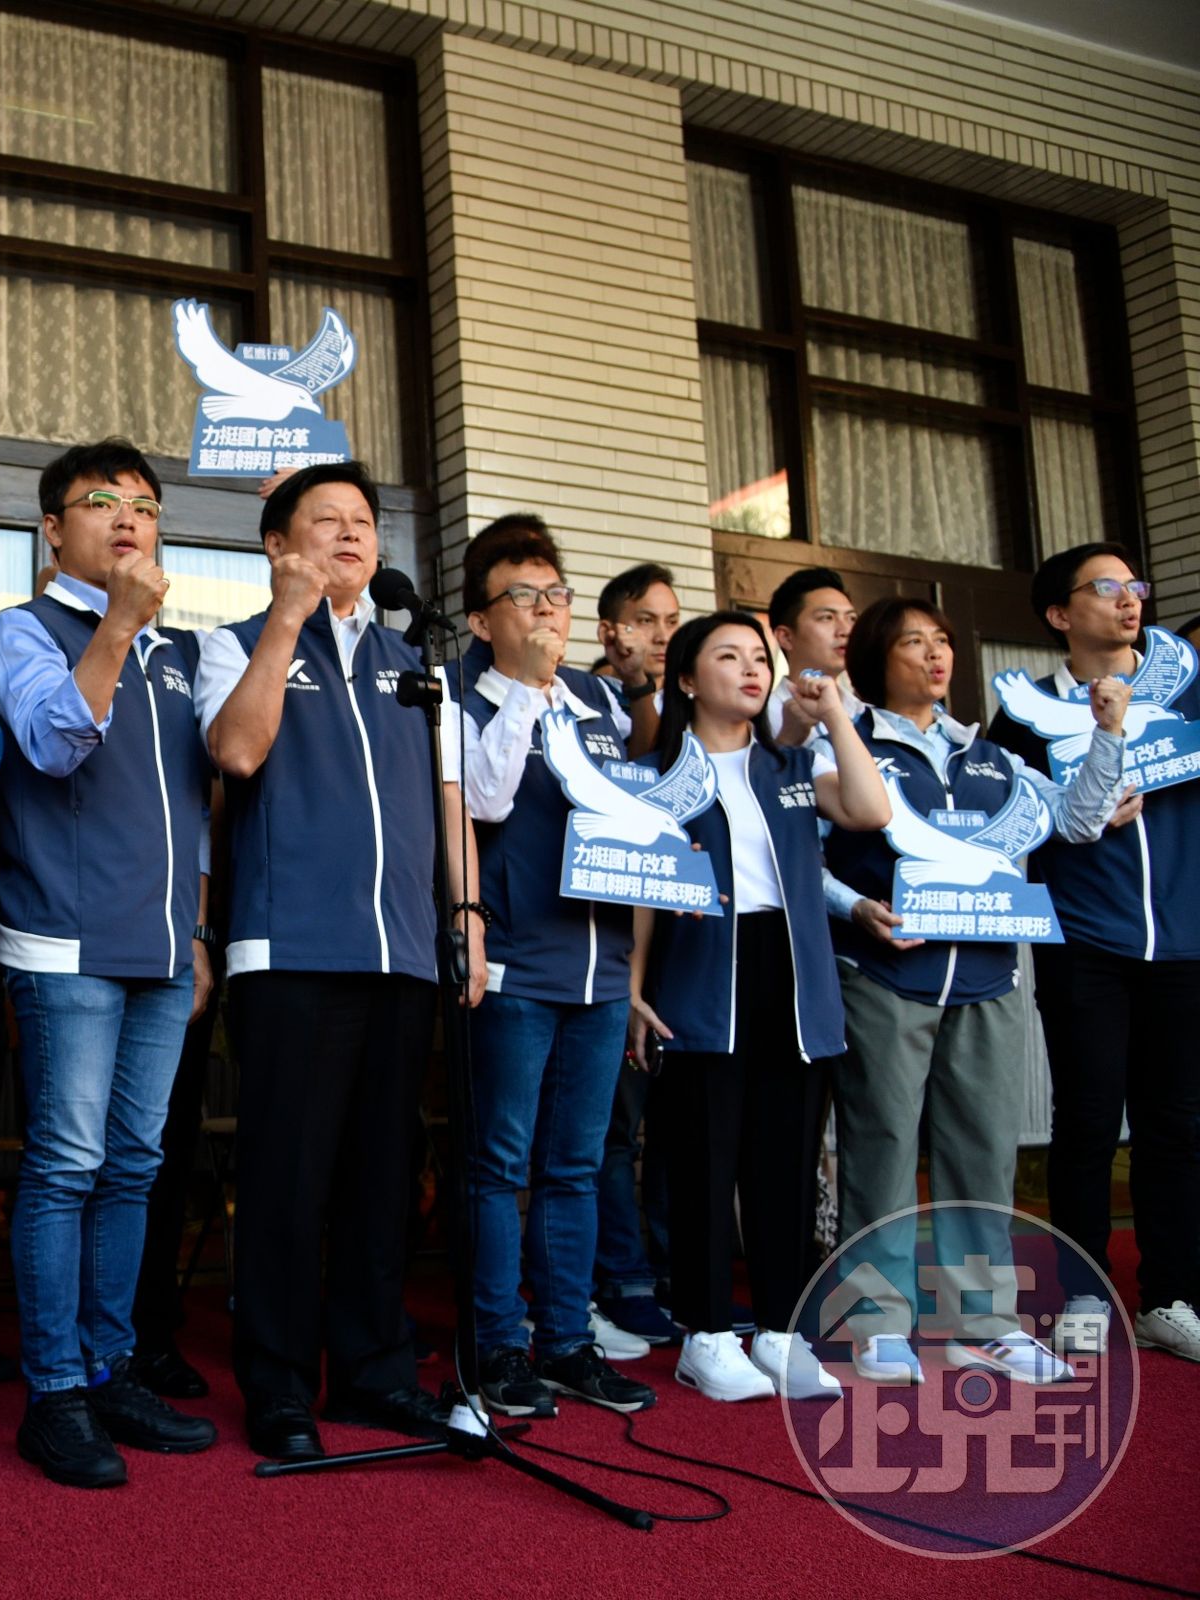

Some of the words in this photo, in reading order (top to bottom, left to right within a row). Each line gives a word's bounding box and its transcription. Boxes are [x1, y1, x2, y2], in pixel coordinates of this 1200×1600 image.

[201, 425, 310, 449] 力挺國會改革
[573, 842, 678, 878] 力挺國會改革
[643, 876, 711, 907] 弊案現形
[902, 890, 1013, 913] 力挺國會改革
[978, 916, 1052, 938] 弊案現形
